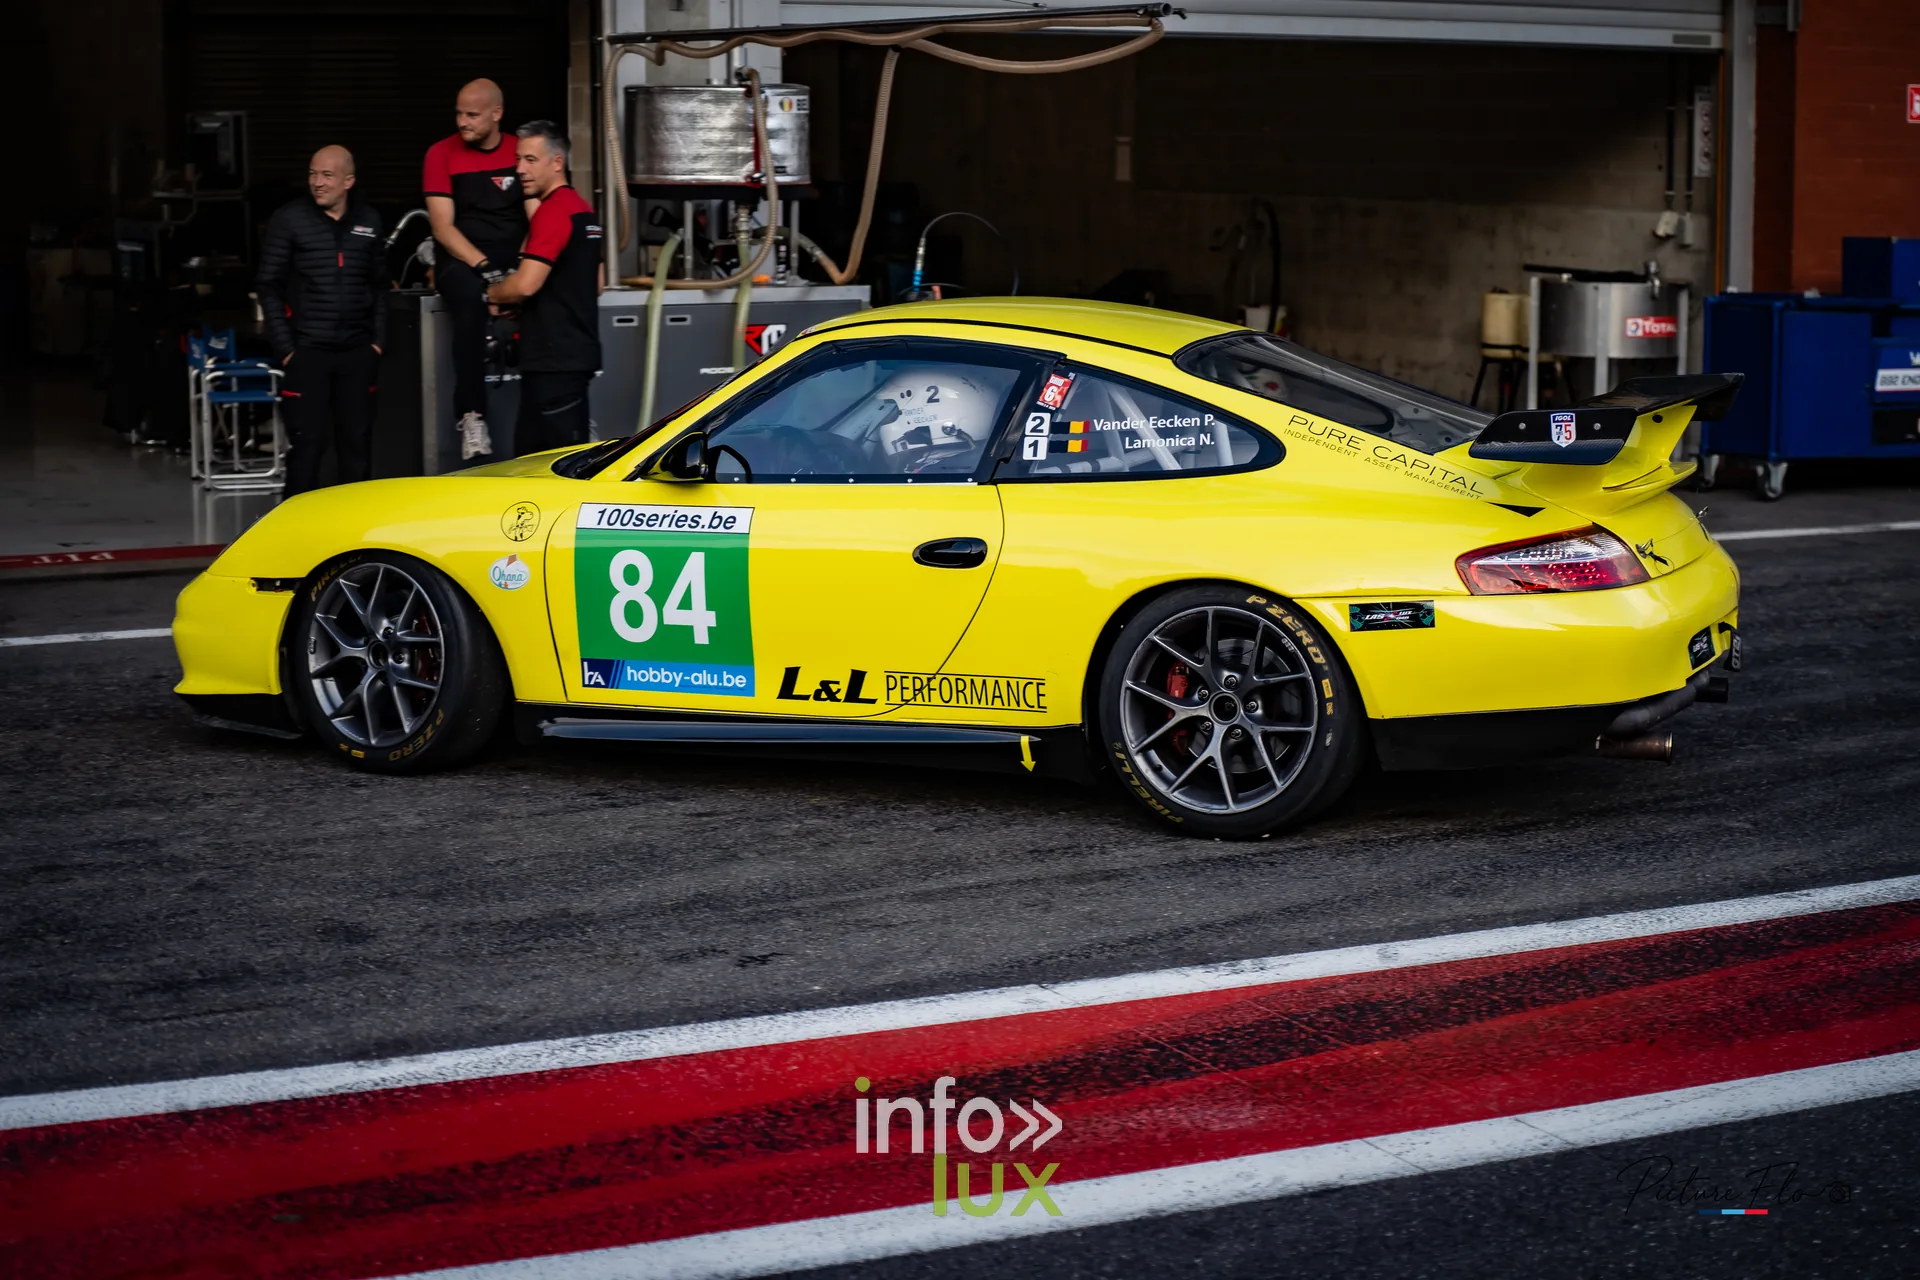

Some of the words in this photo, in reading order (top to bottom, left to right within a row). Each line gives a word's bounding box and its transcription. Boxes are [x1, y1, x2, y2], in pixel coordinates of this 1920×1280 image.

[926, 385, 940, 404] 2
[1044, 385, 1058, 402] 6
[1029, 415, 1045, 434] 2
[1093, 416, 1145, 431] Vander
[1149, 414, 1200, 429] Eecken
[1204, 413, 1216, 426] P.
[1555, 424, 1572, 441] 75
[1028, 439, 1039, 458] 1
[1125, 434, 1195, 449] Lamonica
[1199, 433, 1215, 446] N.
[1284, 428, 1359, 458] INDEPENDENT
[1364, 456, 1400, 472] ASSET
[1404, 470, 1482, 500] MANAGEMENT
[1288, 415, 1366, 451] PURE
[1373, 445, 1484, 495] CAPITAL
[596, 508, 737, 530] 100series.be
[492, 565, 524, 582] Ohana
[609, 549, 717, 645] 84
[1245, 594, 1267, 605] P
[1265, 603, 1326, 664] ZERO
[626, 665, 747, 688] hobby-alu.be
[776, 665, 878, 705] L&L
[885, 674, 1047, 711] PERFORMANCE
[388, 723, 437, 761] ZERO
[1114, 752, 1185, 824] PIRELLI
